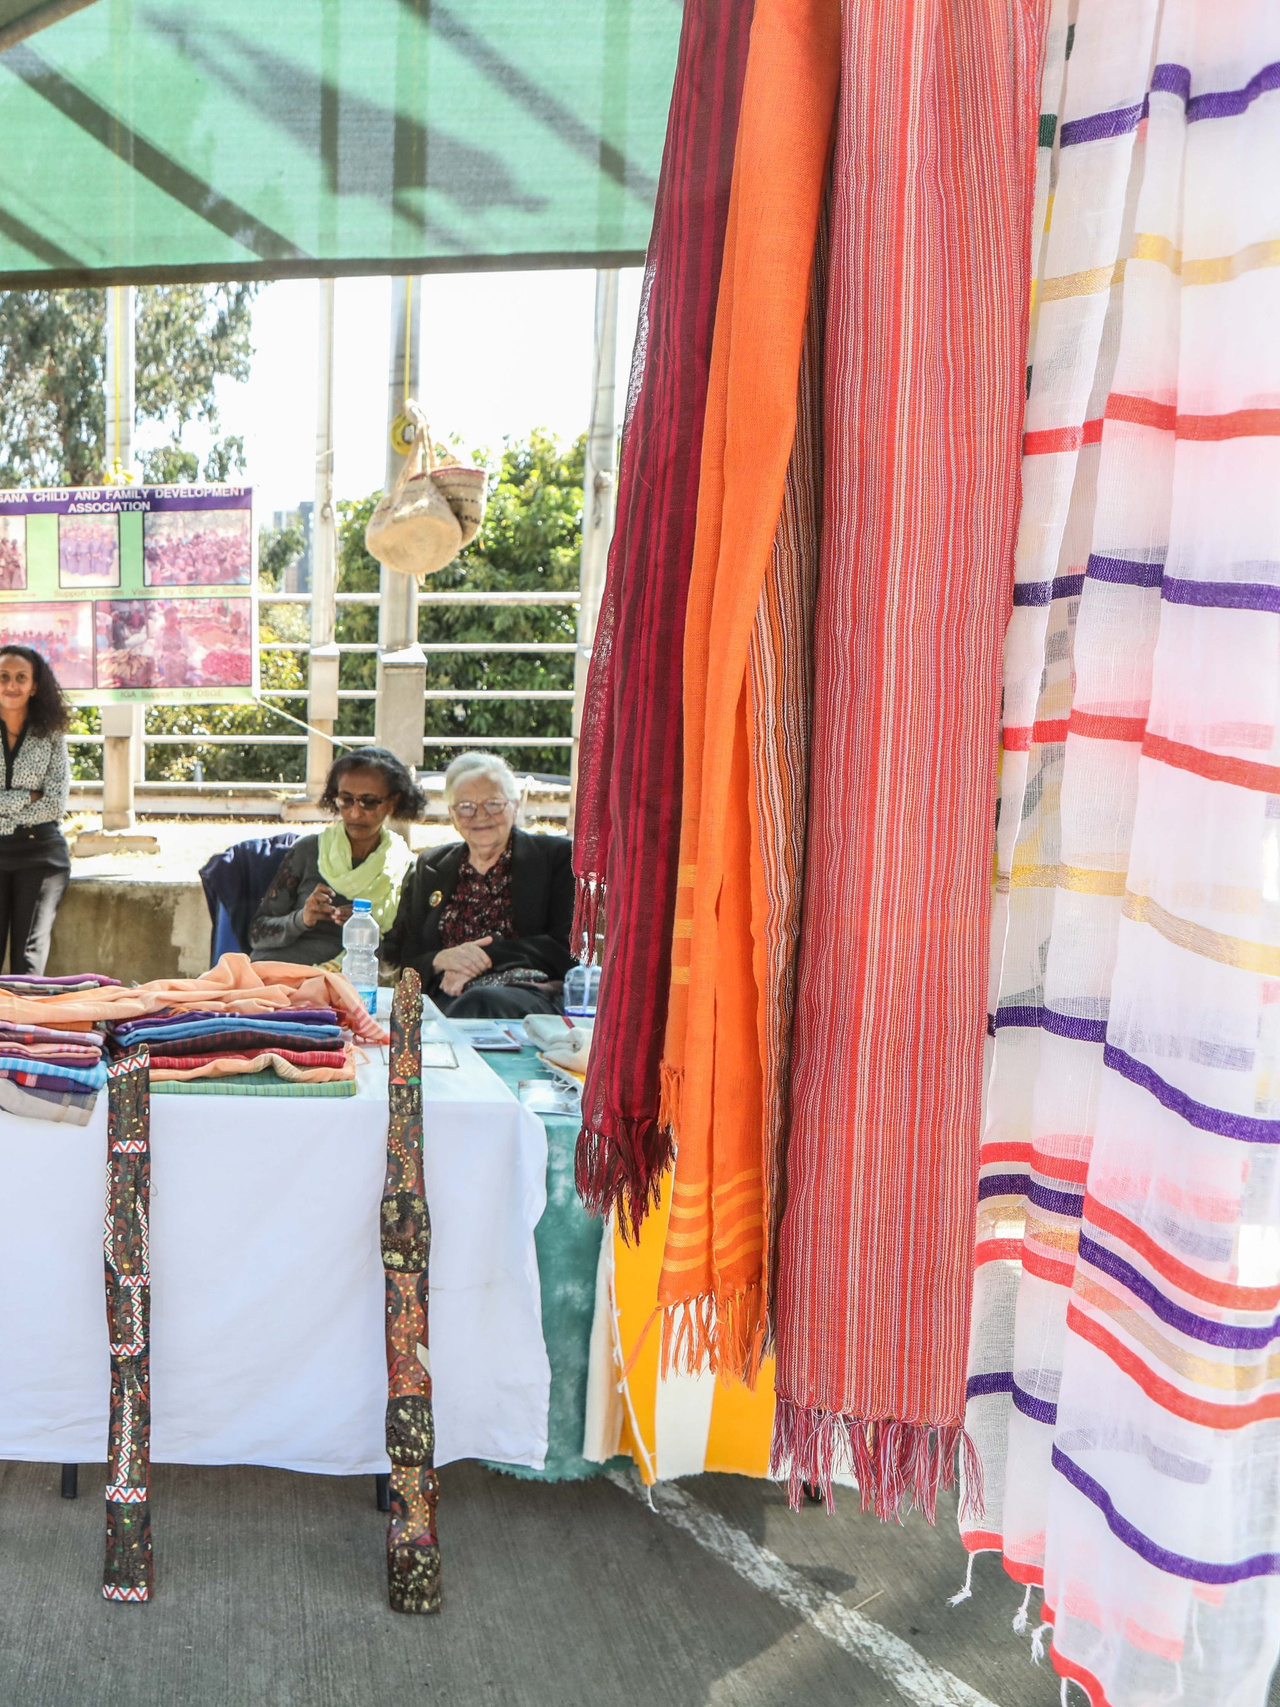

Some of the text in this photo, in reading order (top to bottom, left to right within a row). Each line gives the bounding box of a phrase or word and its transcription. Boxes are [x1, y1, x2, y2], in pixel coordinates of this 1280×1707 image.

[32, 491, 69, 502] CHILD
[74, 490, 101, 501] AND
[105, 488, 150, 500] FAMILY
[155, 486, 246, 499] DEVELOPMENT
[67, 500, 151, 513] ASSOCIATION
[182, 689, 193, 699] by
